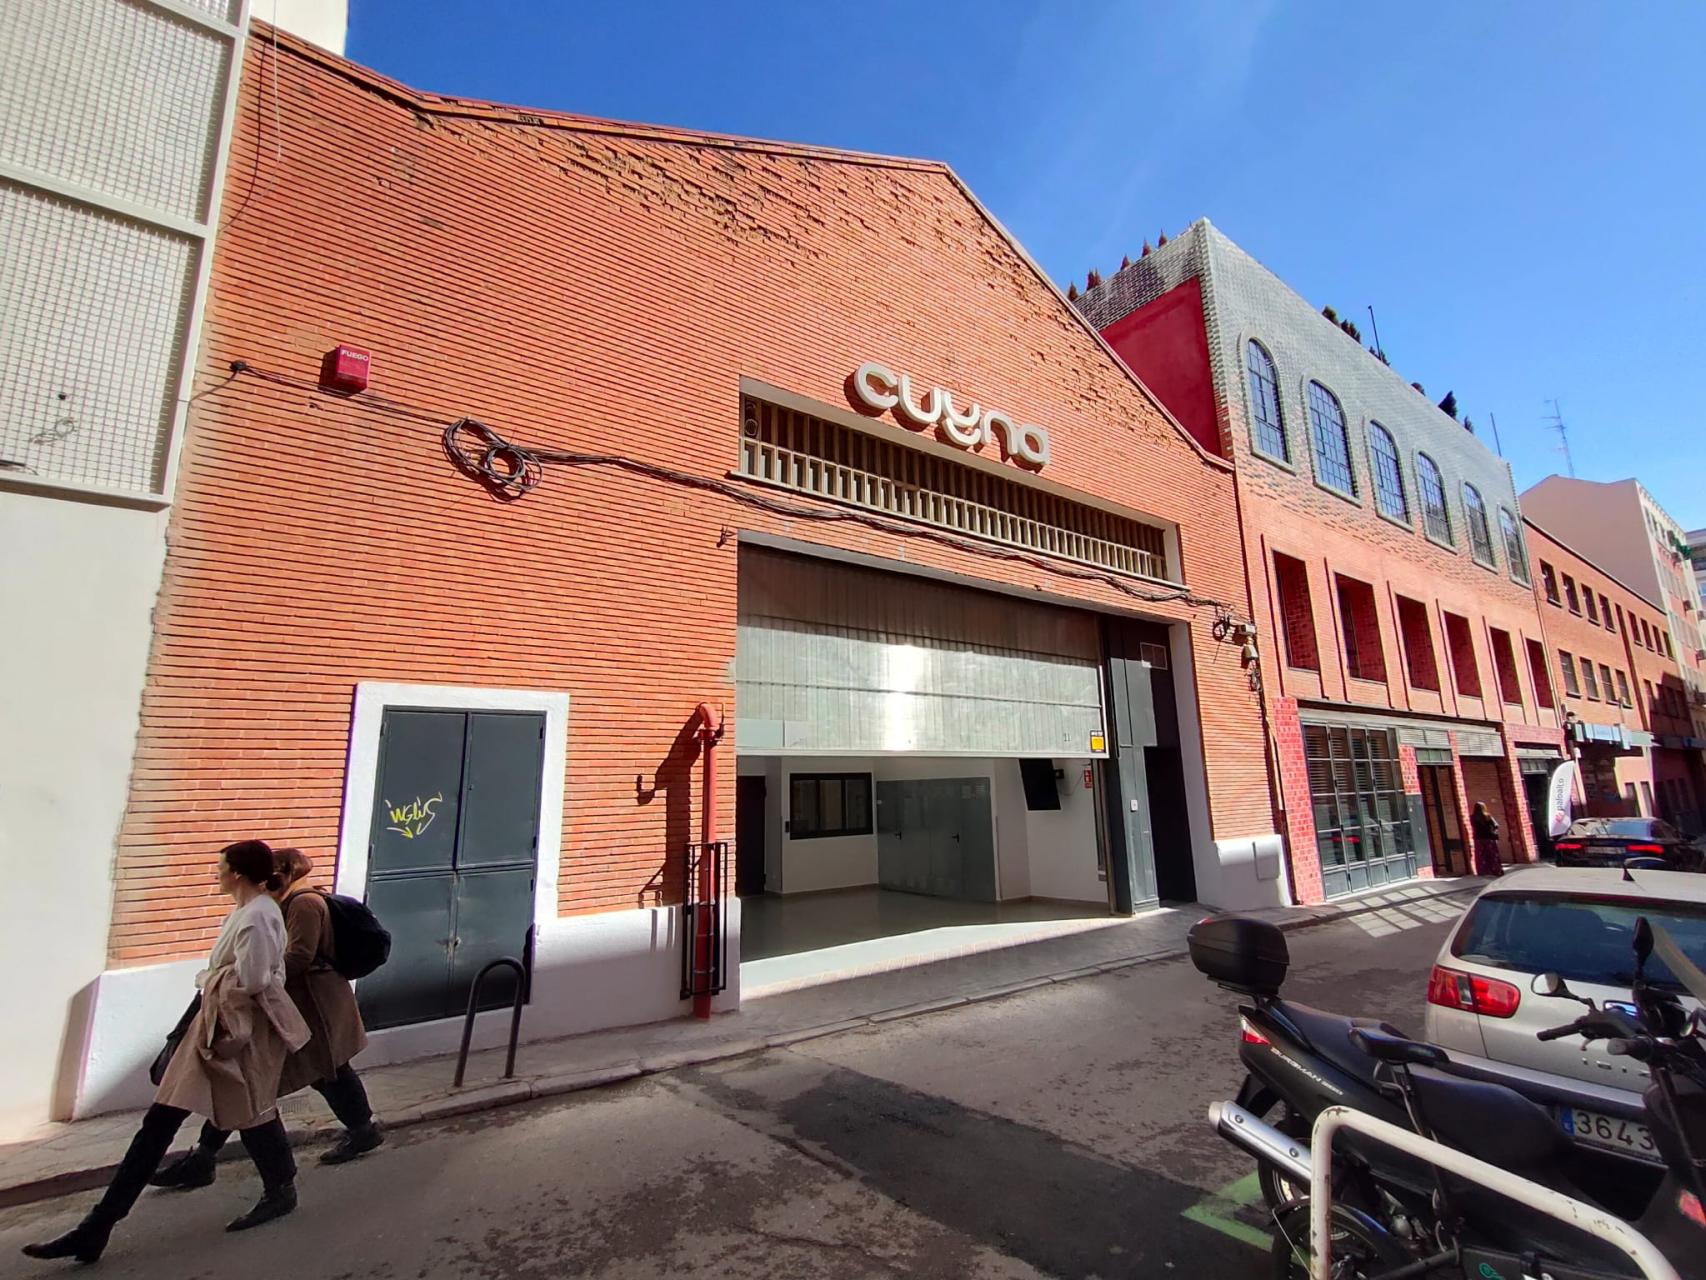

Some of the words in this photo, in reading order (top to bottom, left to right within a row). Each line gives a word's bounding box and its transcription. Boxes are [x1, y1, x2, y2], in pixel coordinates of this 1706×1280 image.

[340, 349, 369, 361] FUEGO
[854, 362, 1050, 464] cuyna
[1577, 1112, 1655, 1150] 3643
